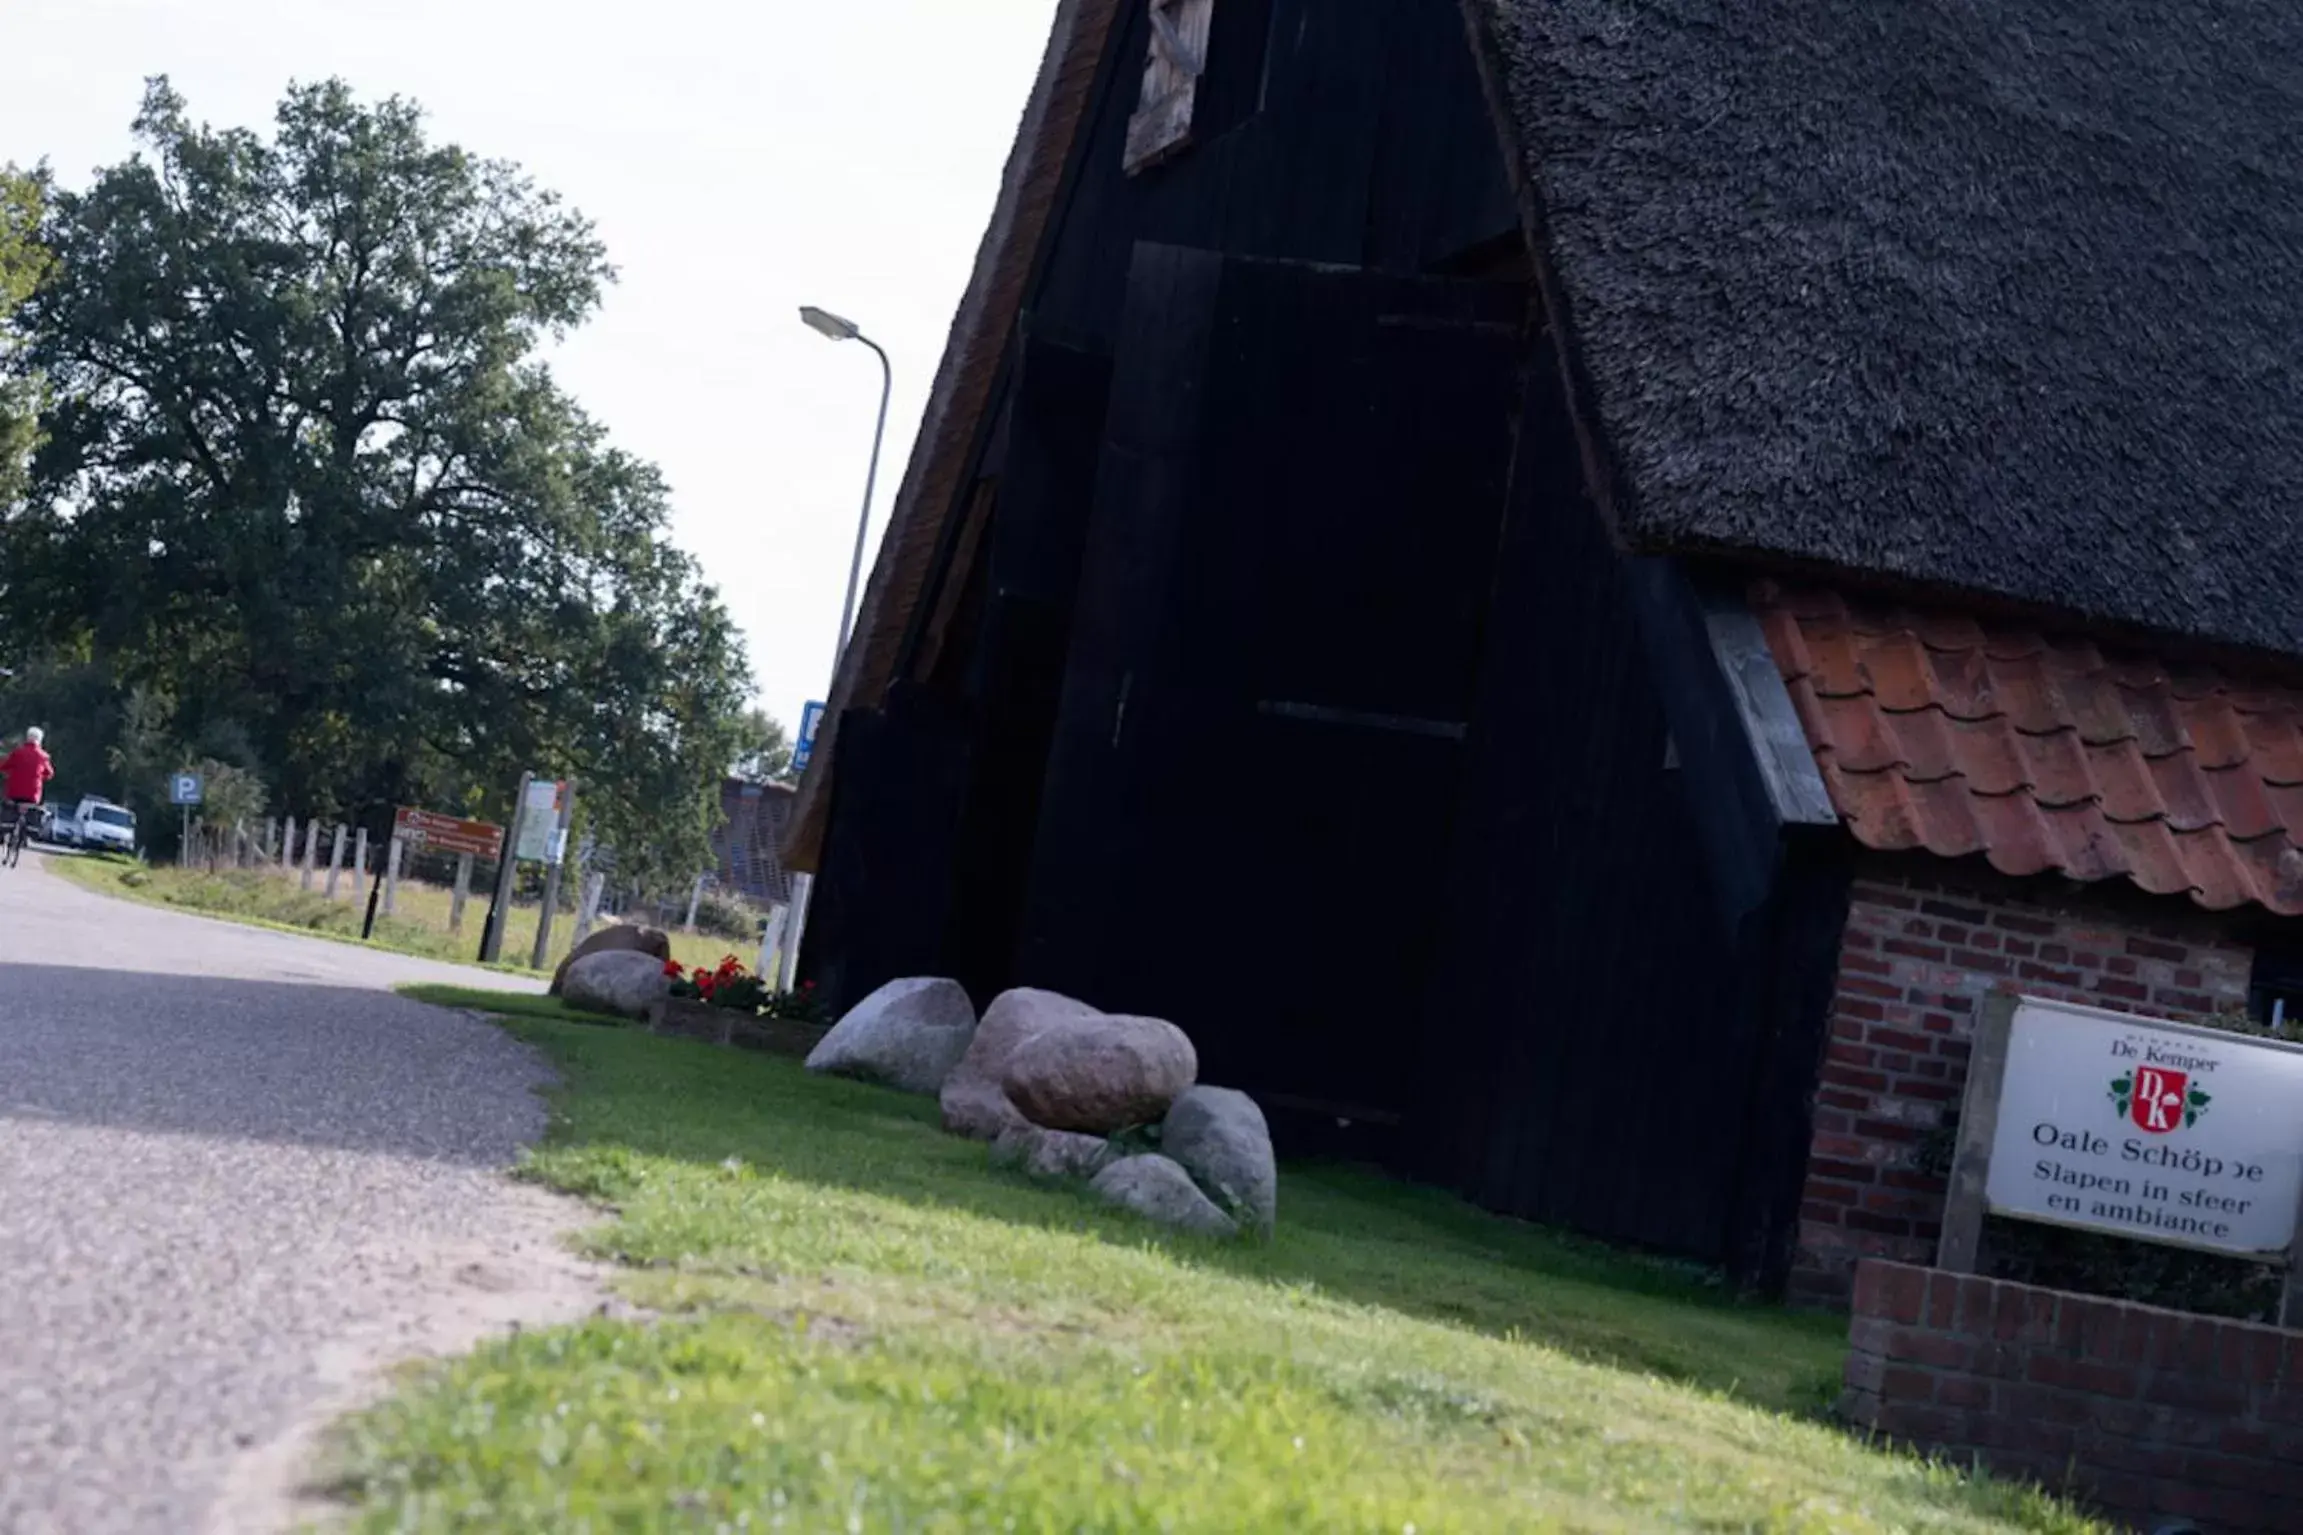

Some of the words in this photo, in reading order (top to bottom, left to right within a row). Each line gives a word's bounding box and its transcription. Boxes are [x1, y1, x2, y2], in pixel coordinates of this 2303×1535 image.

[178, 777, 196, 799] P
[2111, 1039, 2138, 1058] De
[2145, 1045, 2219, 1072] Kemper
[2033, 1122, 2109, 1155] Oale
[2033, 1159, 2130, 1195] Slapen
[2142, 1179, 2168, 1201] in
[2178, 1188, 2252, 1215] sfeer
[2047, 1193, 2080, 1213] en
[2090, 1201, 2229, 1238] ambiance
